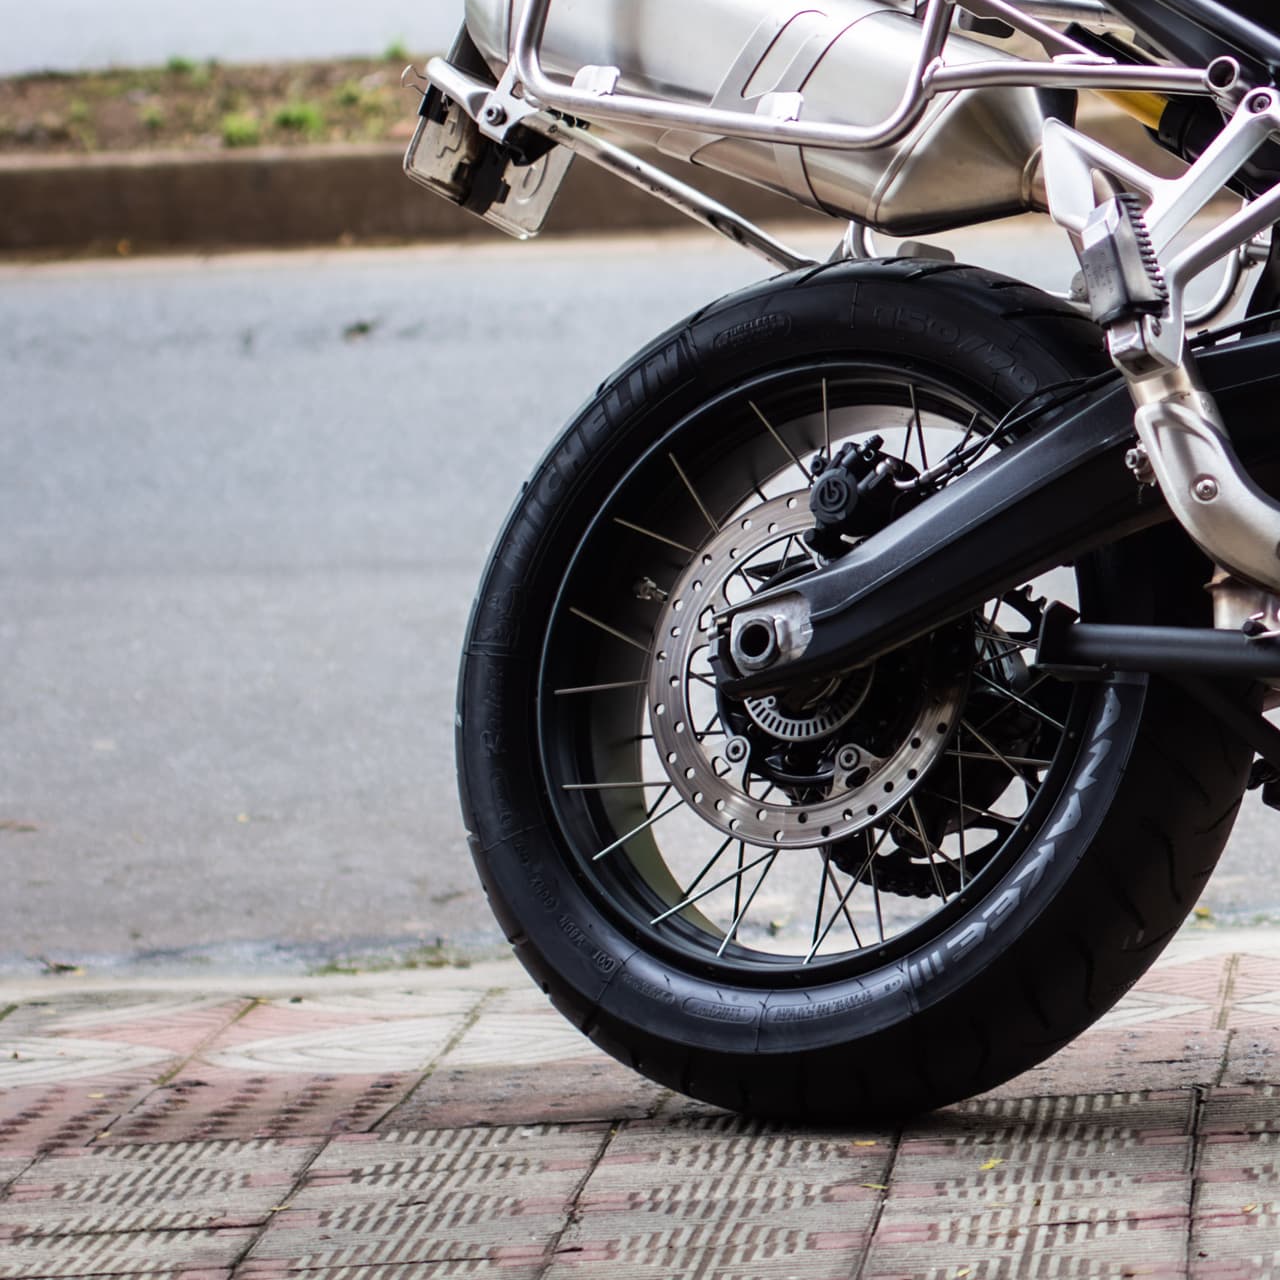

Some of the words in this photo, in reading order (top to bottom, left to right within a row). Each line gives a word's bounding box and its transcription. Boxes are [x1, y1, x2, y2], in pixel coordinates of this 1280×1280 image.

[503, 332, 689, 571] MICHELIN
[946, 687, 1122, 962] ANAKEE
[909, 951, 945, 988] III
